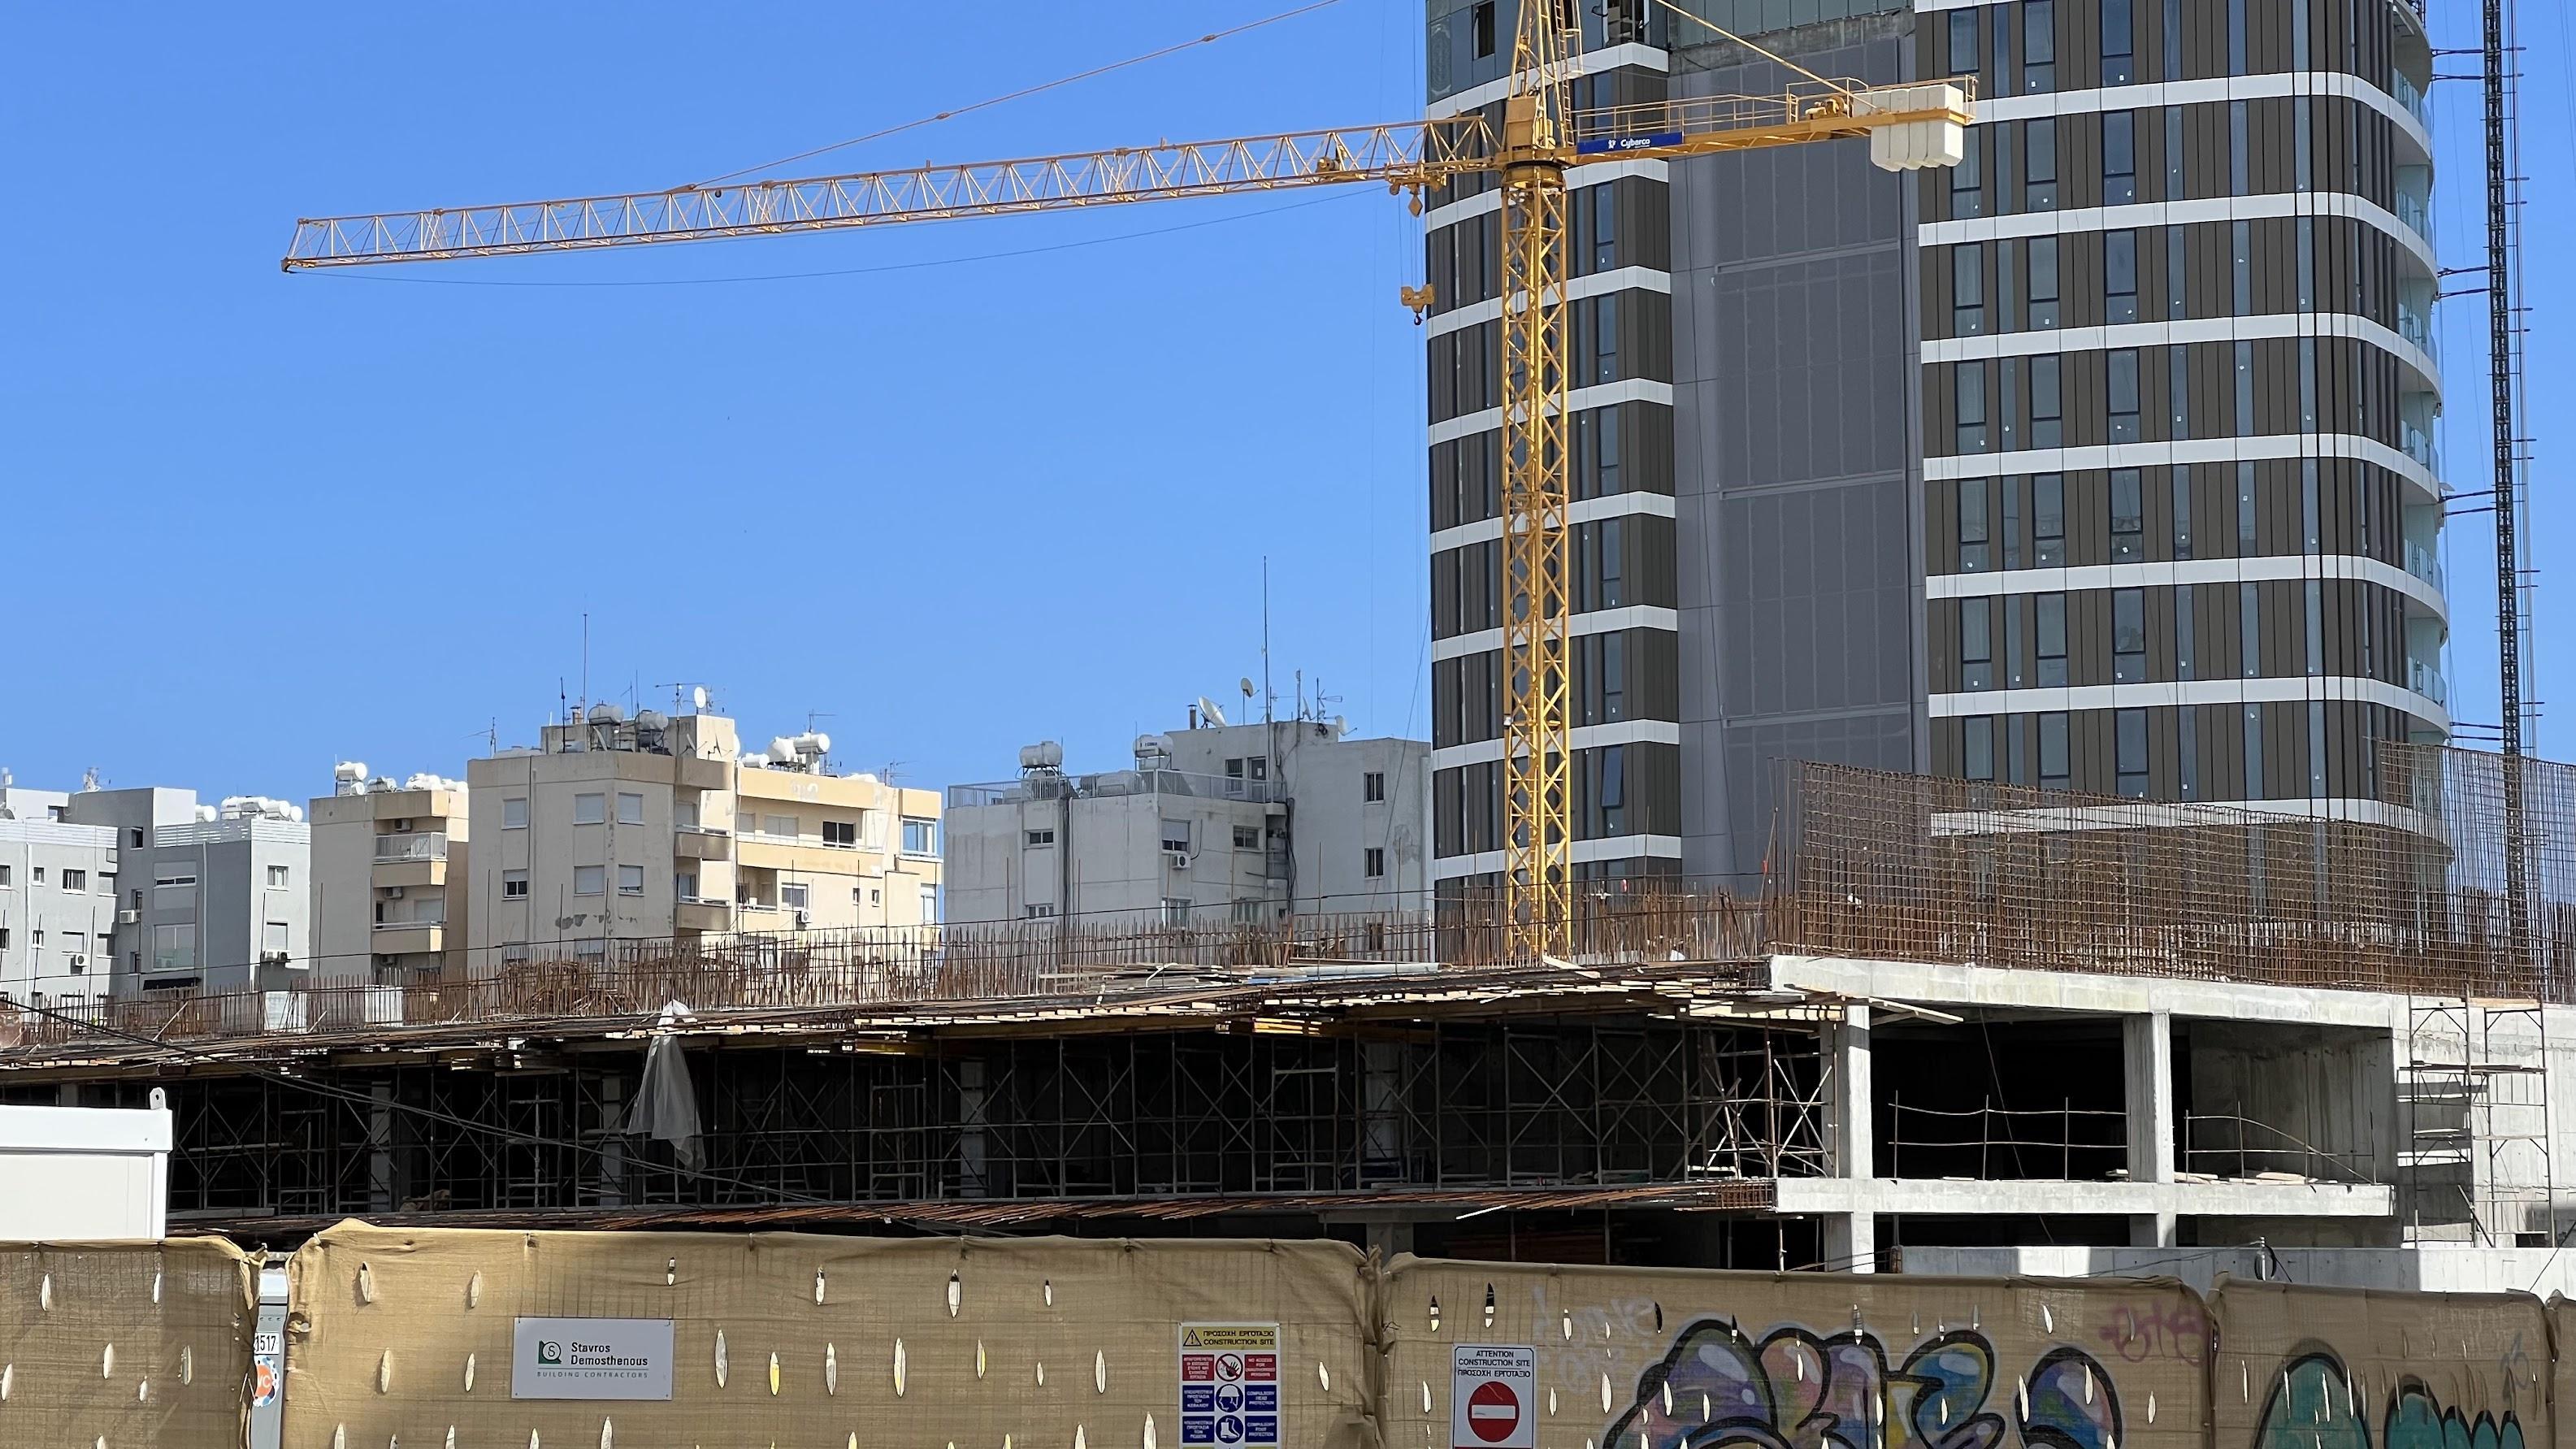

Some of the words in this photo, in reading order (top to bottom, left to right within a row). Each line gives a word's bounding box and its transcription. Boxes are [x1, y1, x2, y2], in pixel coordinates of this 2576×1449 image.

[571, 1342, 610, 1352] Stavros
[570, 1356, 648, 1366] Demosthenous
[1458, 1358, 1513, 1366] CONSTRUCTION
